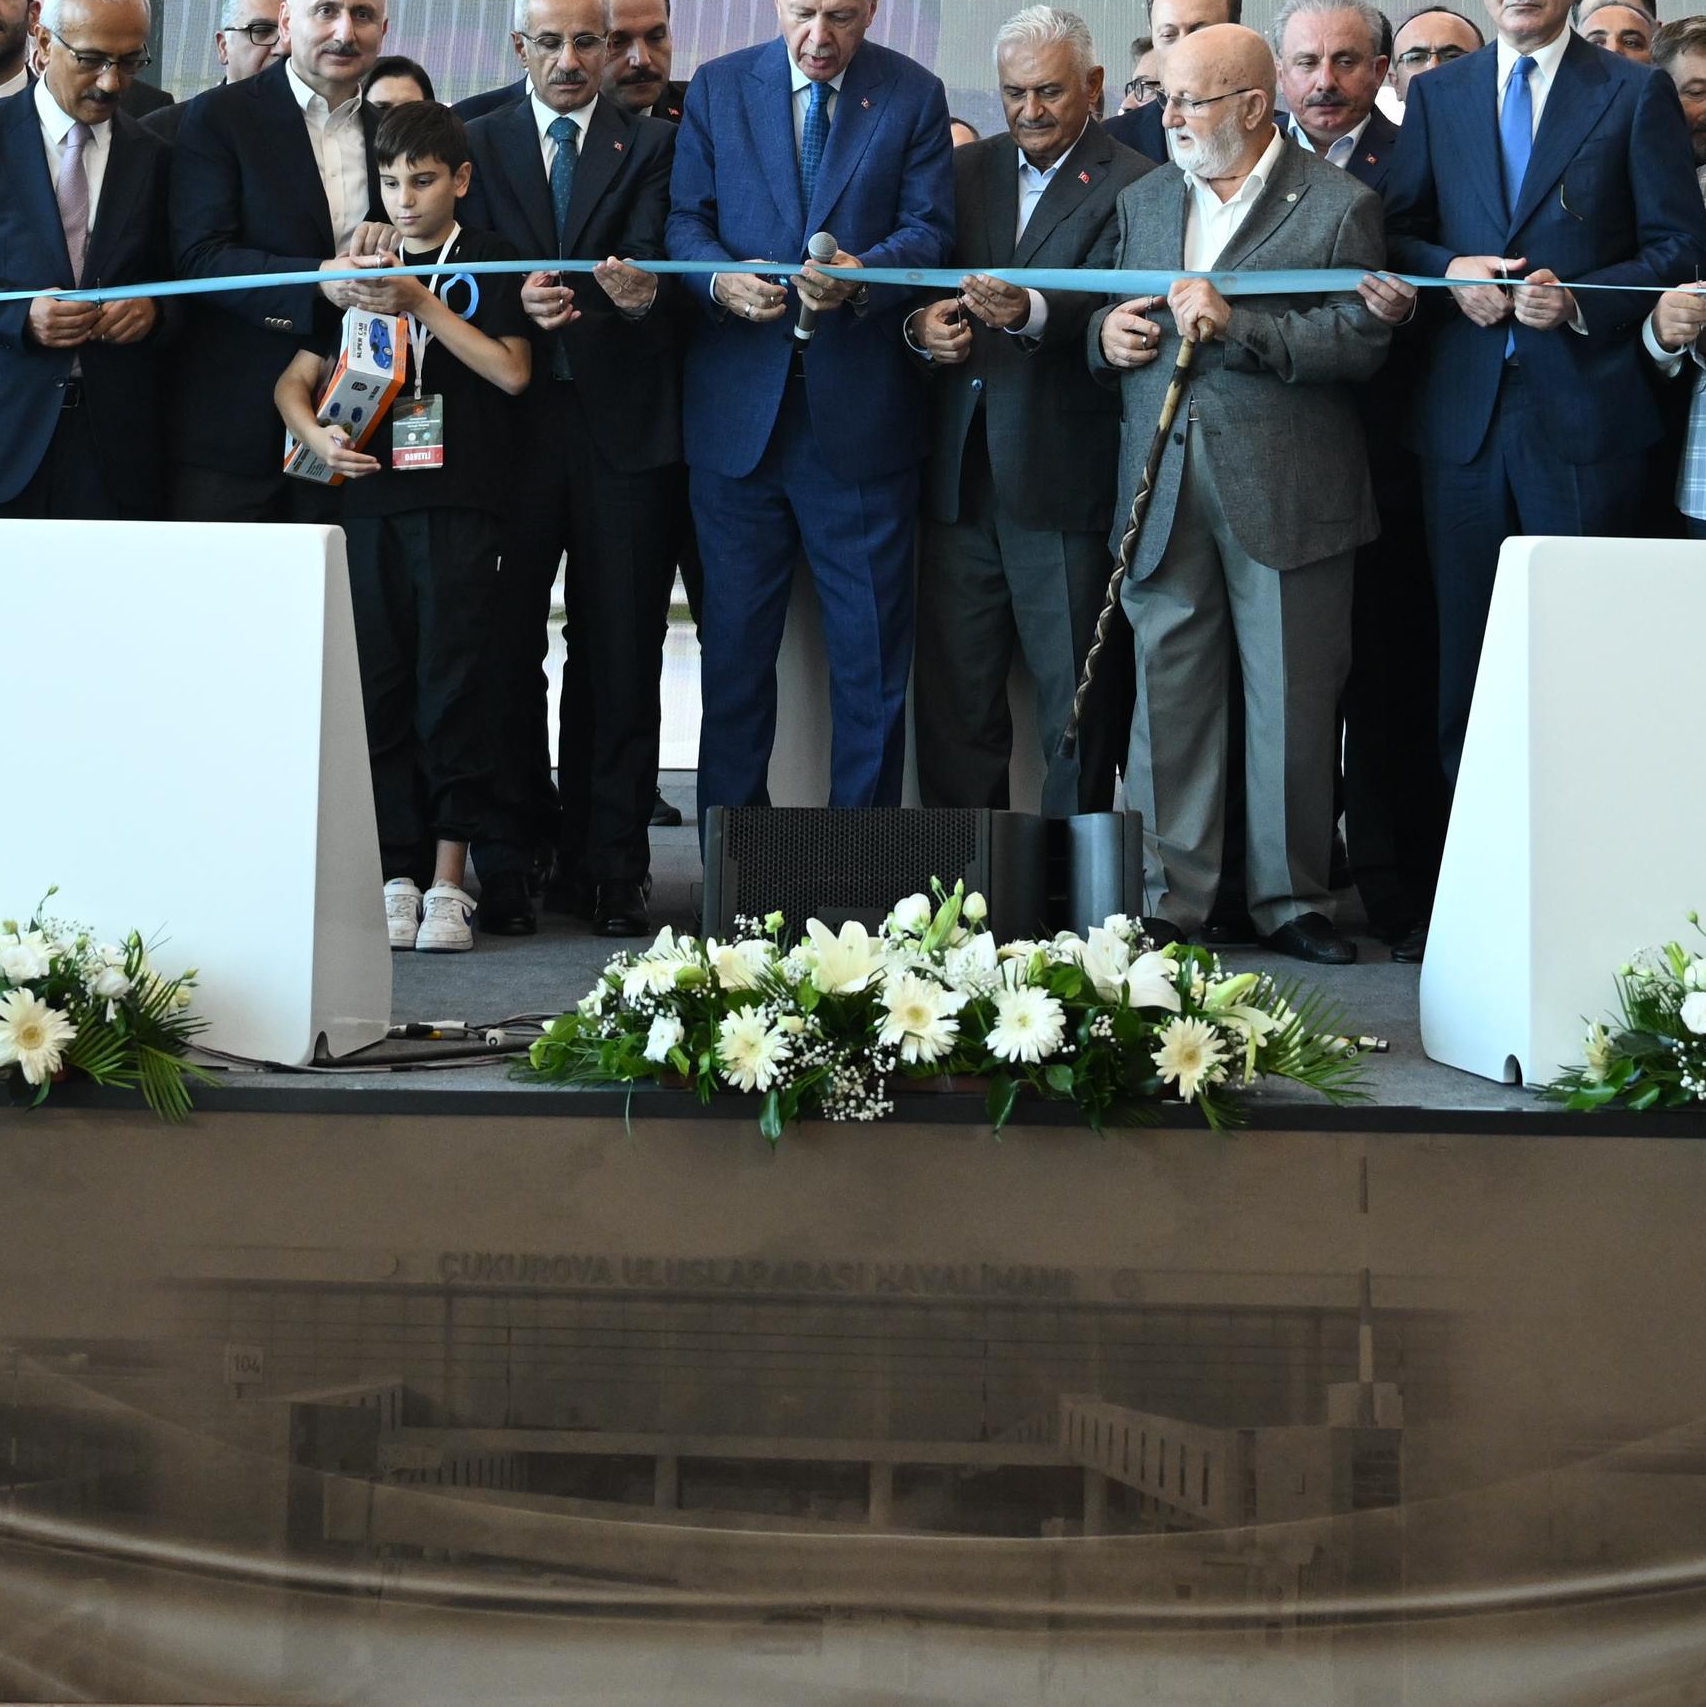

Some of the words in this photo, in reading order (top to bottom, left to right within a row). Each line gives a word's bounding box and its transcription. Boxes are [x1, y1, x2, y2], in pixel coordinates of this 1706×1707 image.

[405, 451, 431, 461] DAVETLİ
[437, 1250, 613, 1286] ÇUKUROVA
[622, 1254, 864, 1292] ULUSLARARASI
[234, 1354, 261, 1374] 104
